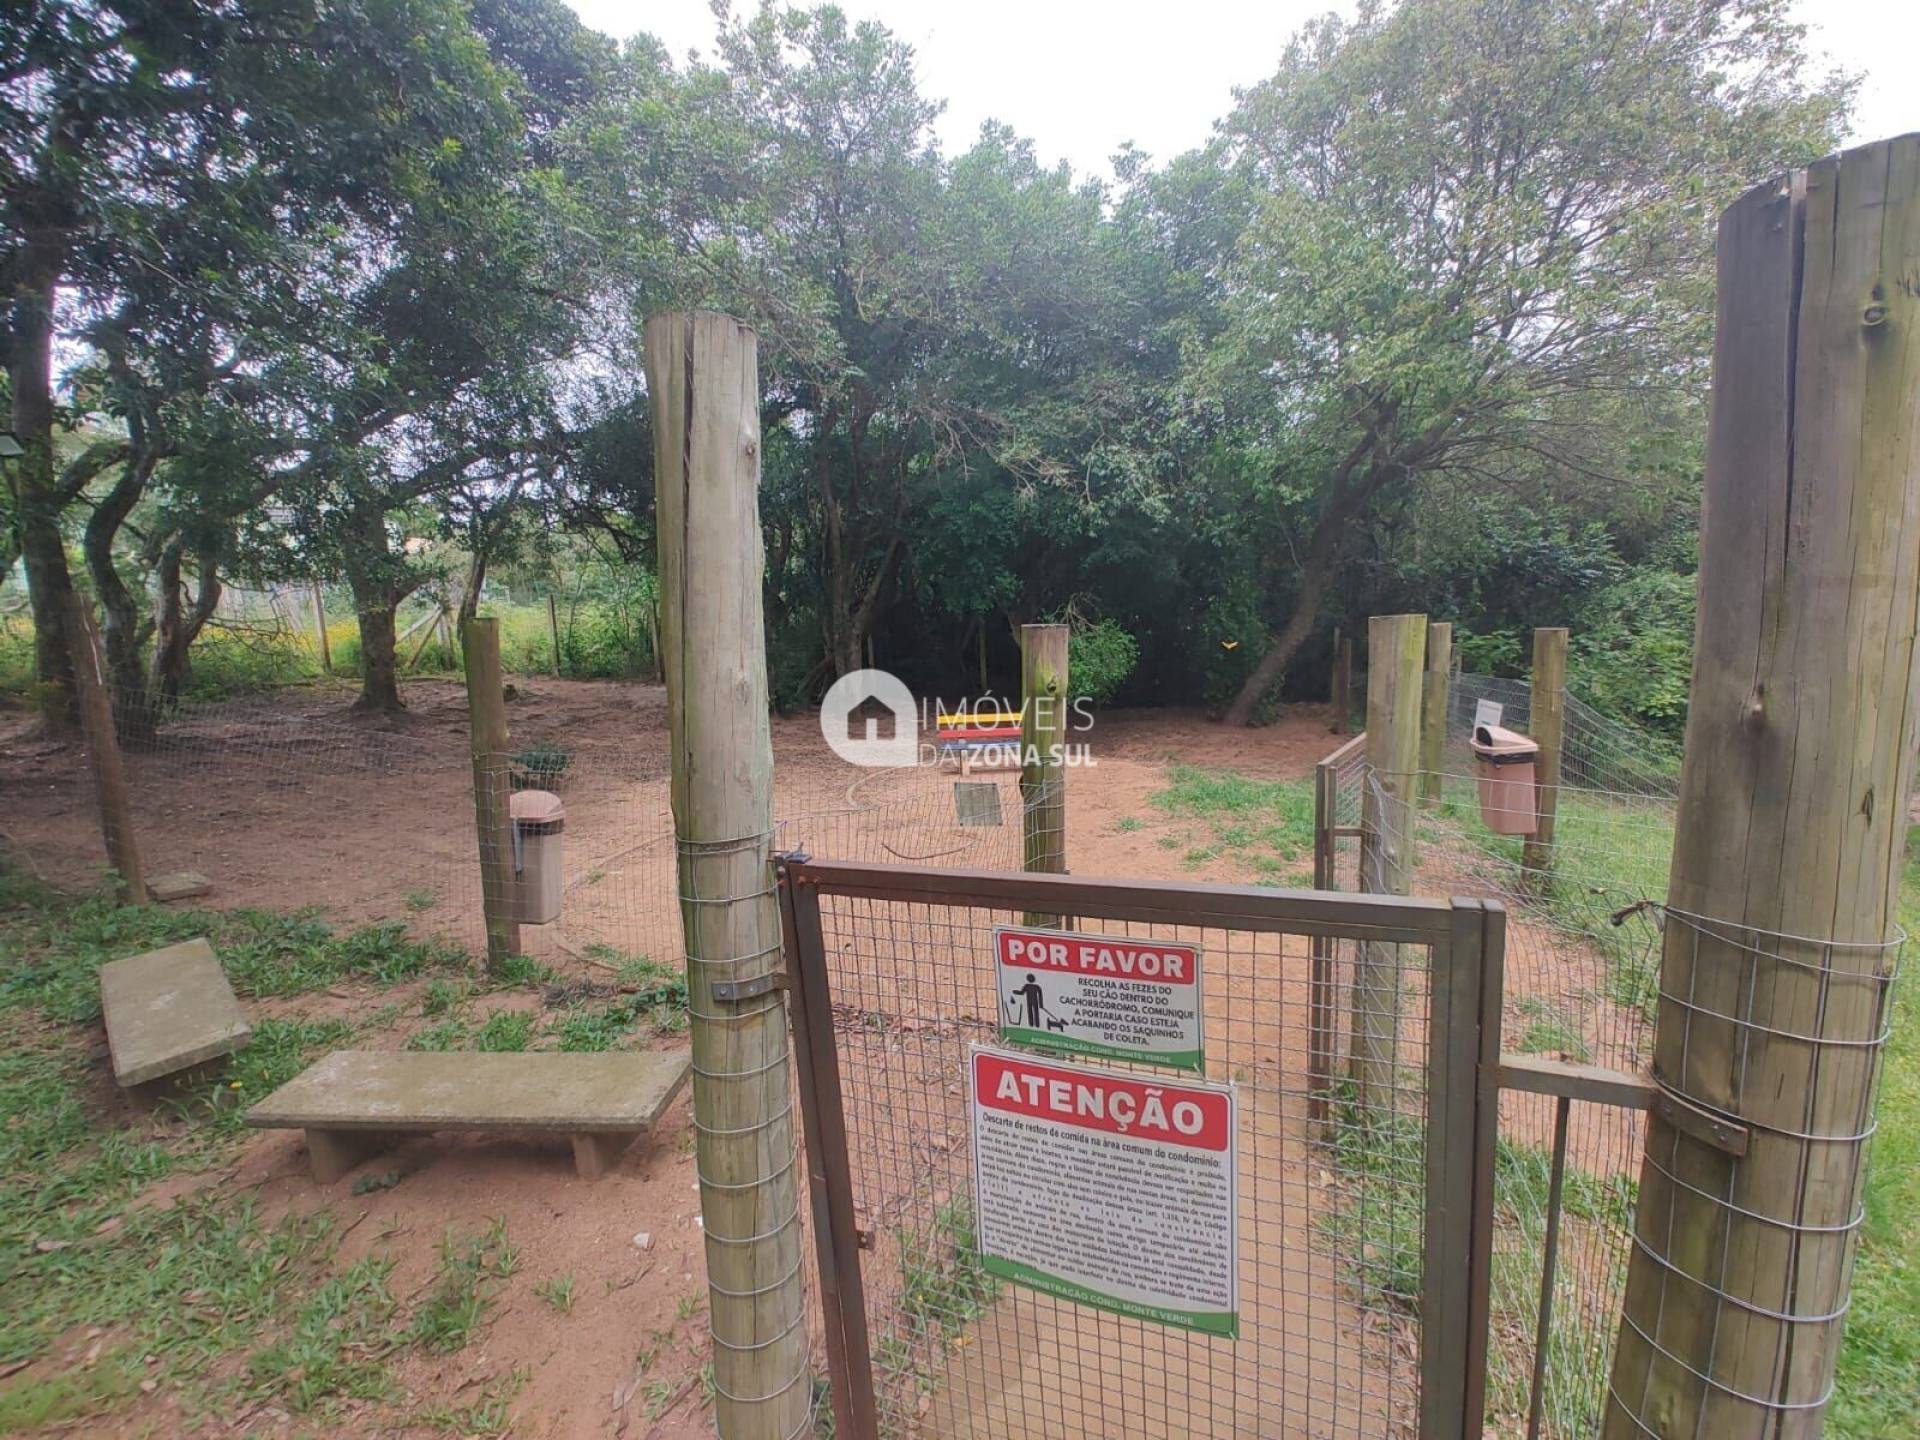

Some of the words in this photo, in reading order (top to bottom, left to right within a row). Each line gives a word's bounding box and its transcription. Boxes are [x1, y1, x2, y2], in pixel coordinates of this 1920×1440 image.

[1008, 940, 1068, 966] POR
[1079, 946, 1184, 978] FAVOR
[1078, 978, 1116, 989] RECOLHA
[1120, 982, 1129, 990] AS
[1132, 983, 1156, 993] FEZES
[1083, 989, 1098, 997] SEU
[1099, 989, 1118, 1000] CÃO
[1120, 993, 1153, 1004] DENTRO
[1082, 1010, 1121, 1021] PORTARIA
[1125, 1014, 1148, 1024] CASO
[1151, 1018, 1179, 1028] ESTEJA
[1142, 1006, 1194, 1019] COMUNIQUE
[1072, 1018, 1117, 1030] ACABANDO
[1134, 1026, 1184, 1039] SAQUINHOS
[996, 1070, 1204, 1134] ATENÇÃO
[982, 1111, 1013, 1127] Descarte
[1014, 1118, 1023, 1129] de
[1025, 1122, 1047, 1134] restos
[1049, 1125, 1059, 1137] de
[1060, 1130, 1089, 1143] comida
[1090, 1136, 1101, 1146] na
[1102, 1136, 1119, 1149] área
[1122, 1142, 1152, 1156] comum
[1154, 1146, 1166, 1159] do
